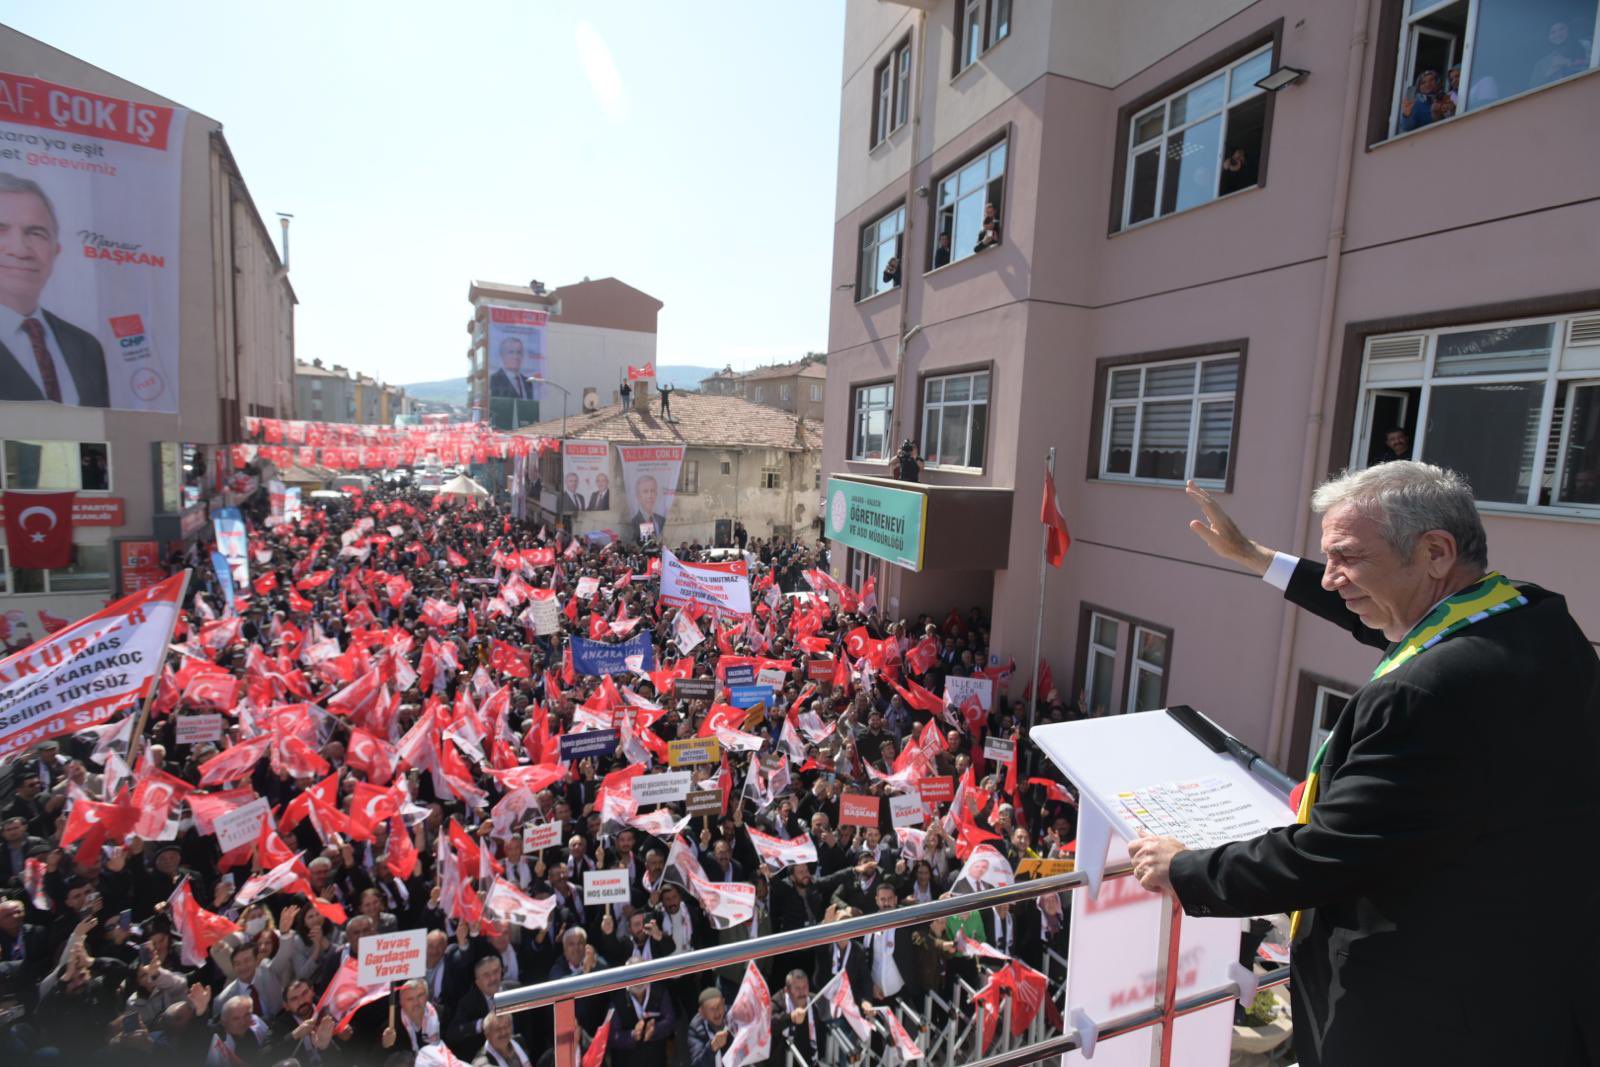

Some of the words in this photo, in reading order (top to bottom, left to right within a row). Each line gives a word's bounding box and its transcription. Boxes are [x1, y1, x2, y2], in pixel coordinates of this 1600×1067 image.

[48, 90, 117, 131] ÇOK
[126, 100, 157, 143] İŞ
[26, 151, 118, 176] görevimiz
[84, 246, 165, 268] BAŞKAN
[120, 336, 144, 348] CHP
[850, 504, 905, 534] ÖĞRETMENEVİ
[849, 525, 856, 534] VE
[868, 530, 904, 551] MÜDÜRLÜĞÜ
[581, 650, 623, 660] ANKARA
[55, 651, 143, 686] KARAKOÇ
[56, 673, 129, 703] TÜYSÜZ
[844, 809, 877, 818] BAŞKAN
[896, 808, 921, 818] BAŞKAN
[602, 888, 626, 897] GELDİN
[376, 937, 411, 950] Yavaş
[365, 949, 420, 967] Gardaşım
[375, 963, 410, 977] Yavaş
